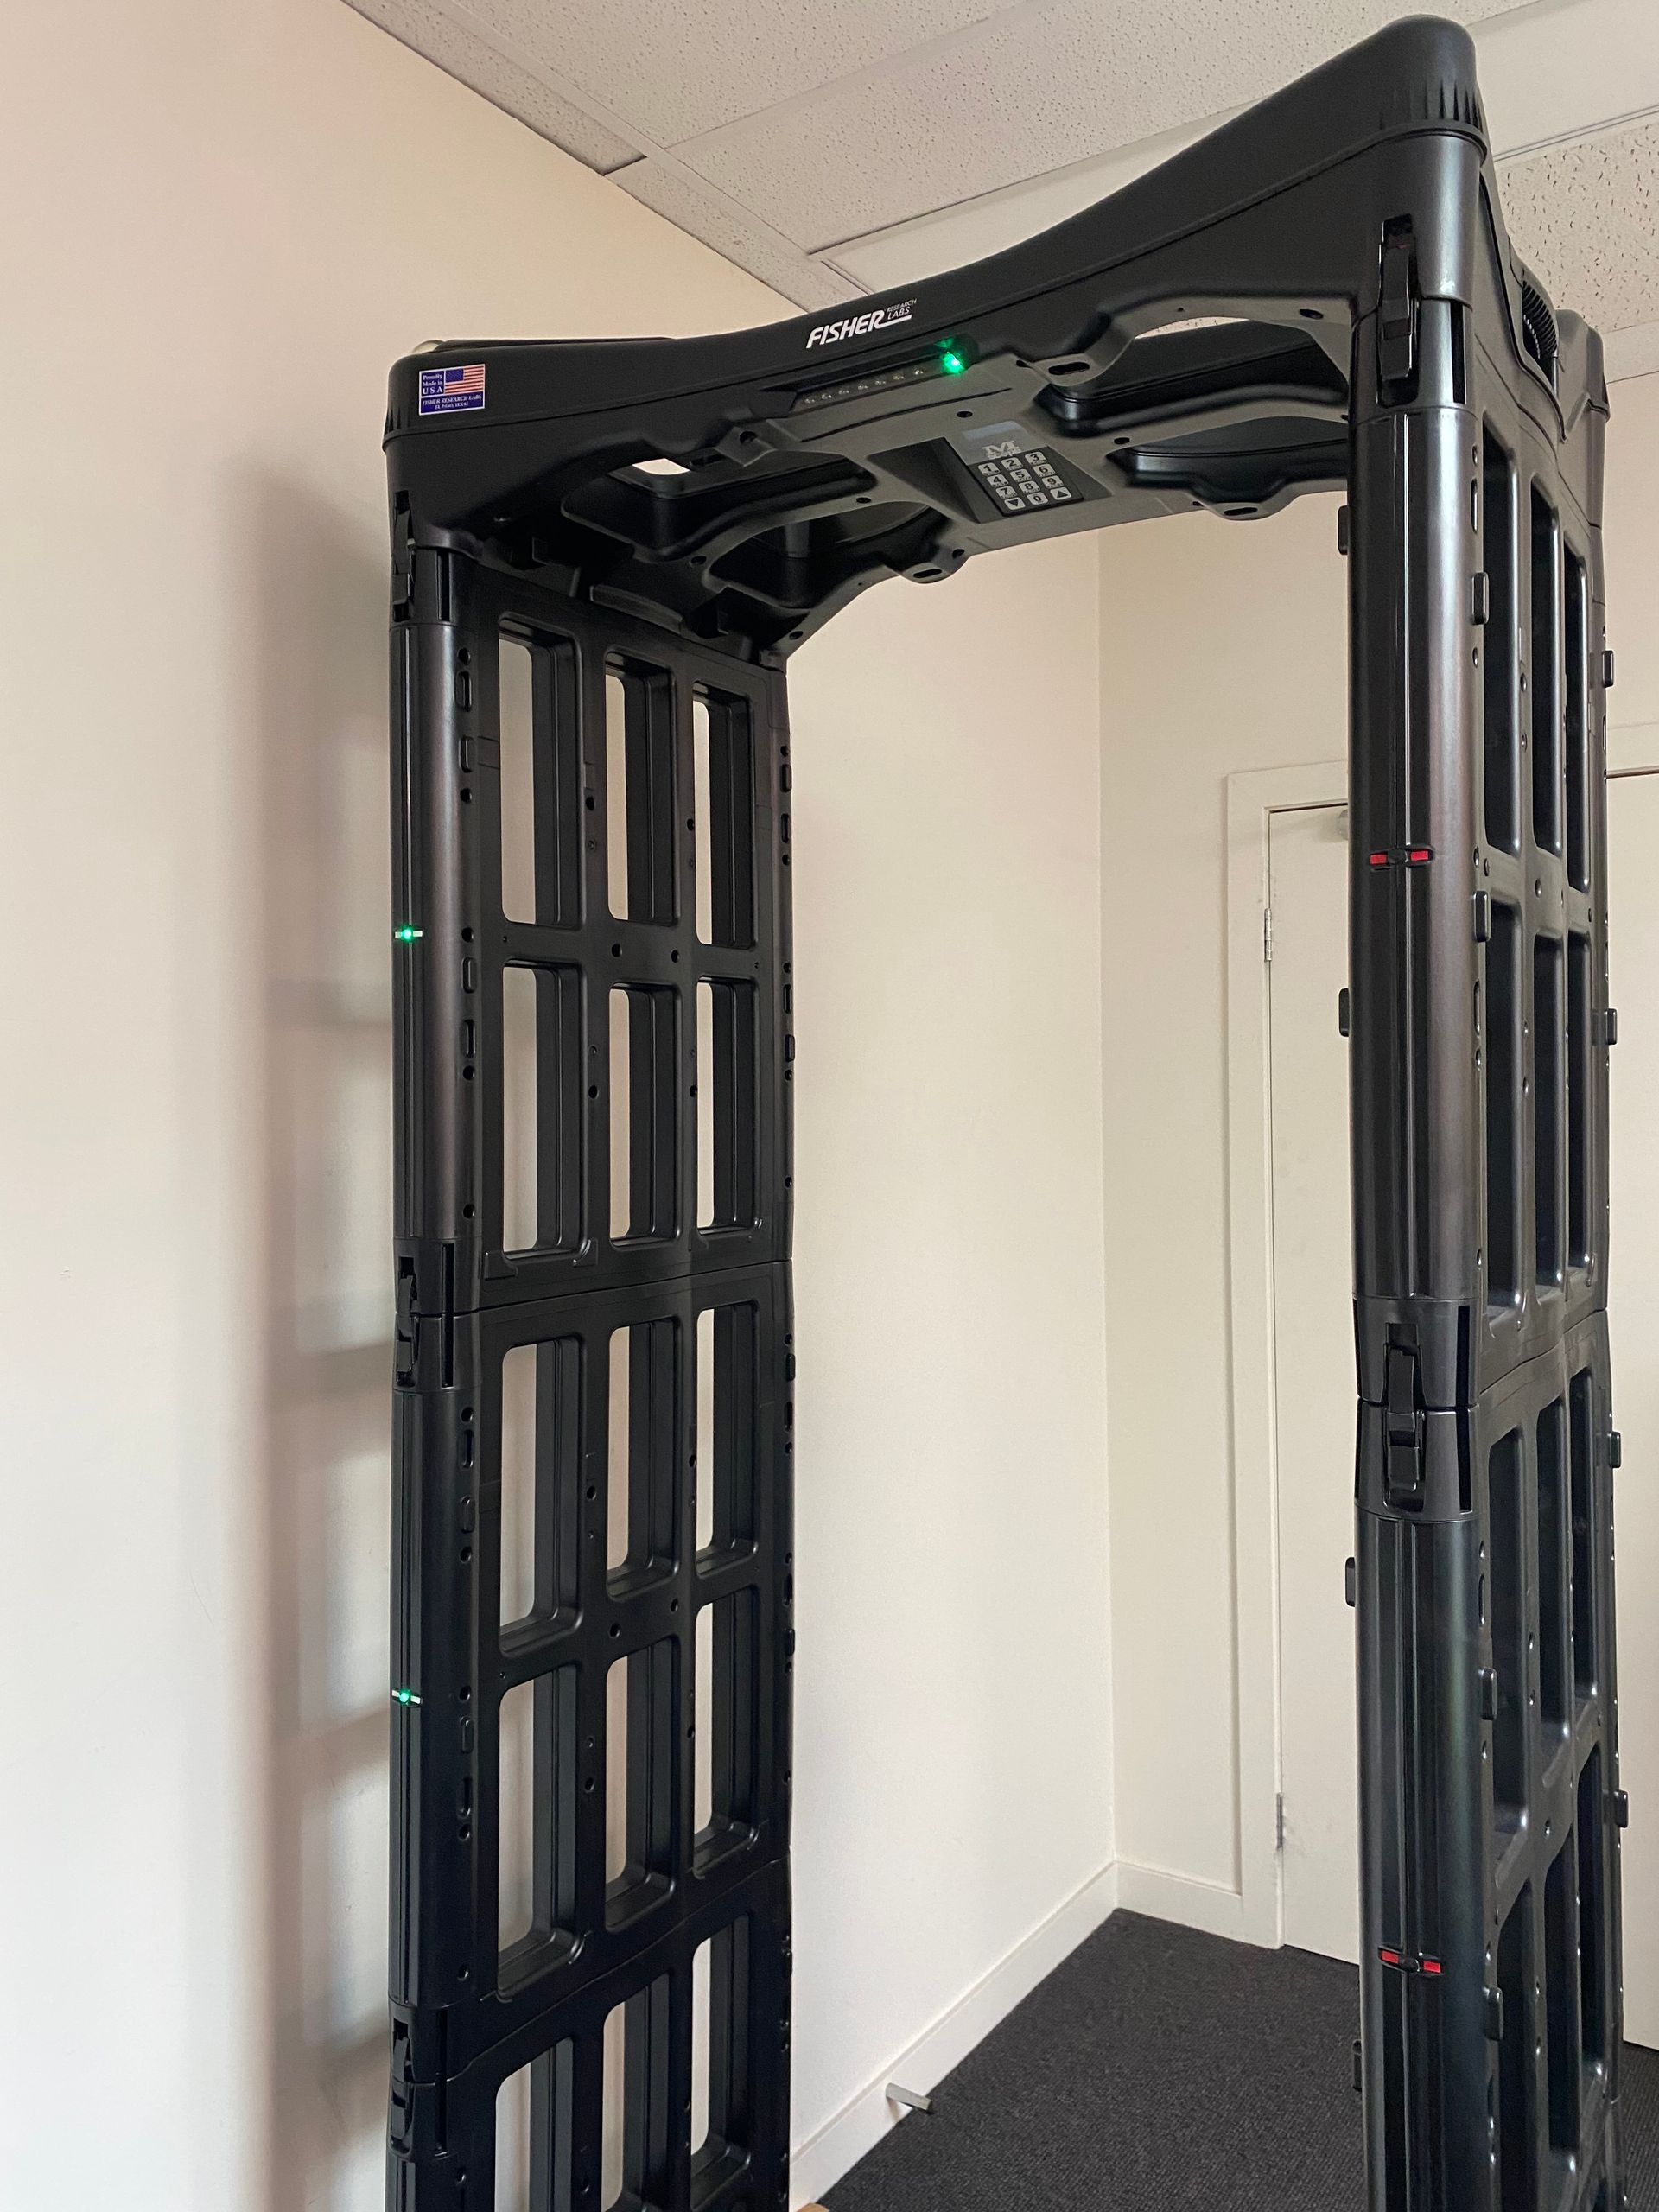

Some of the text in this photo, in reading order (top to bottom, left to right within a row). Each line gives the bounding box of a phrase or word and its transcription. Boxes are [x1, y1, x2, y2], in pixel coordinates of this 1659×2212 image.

[887, 298, 917, 312] RESEARCH
[887, 307, 910, 320] LABS
[806, 309, 912, 348] FISHER
